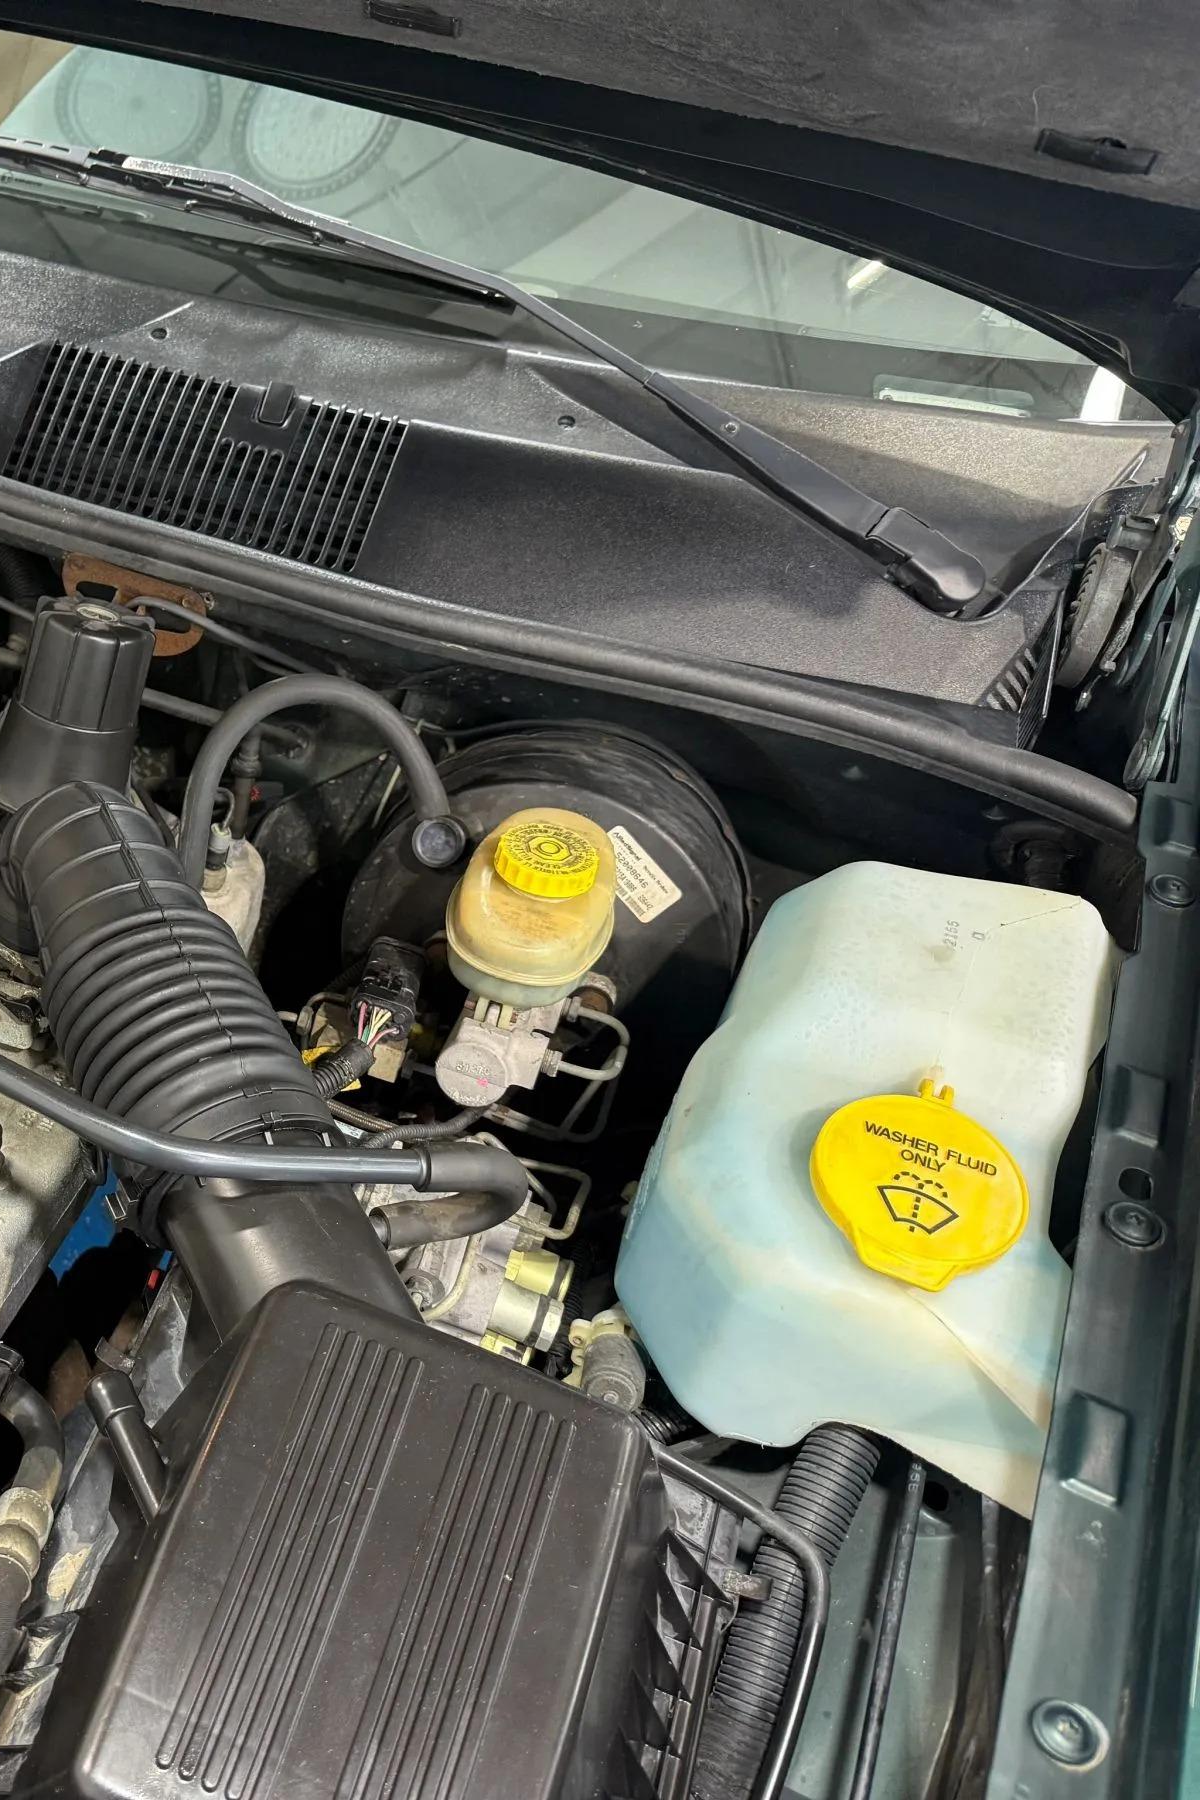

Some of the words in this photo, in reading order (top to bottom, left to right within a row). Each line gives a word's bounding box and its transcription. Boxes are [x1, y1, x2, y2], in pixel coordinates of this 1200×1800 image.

[865, 1120, 939, 1156] WASHER
[946, 1149, 997, 1176] FLUID
[900, 1149, 946, 1172] ONLY
